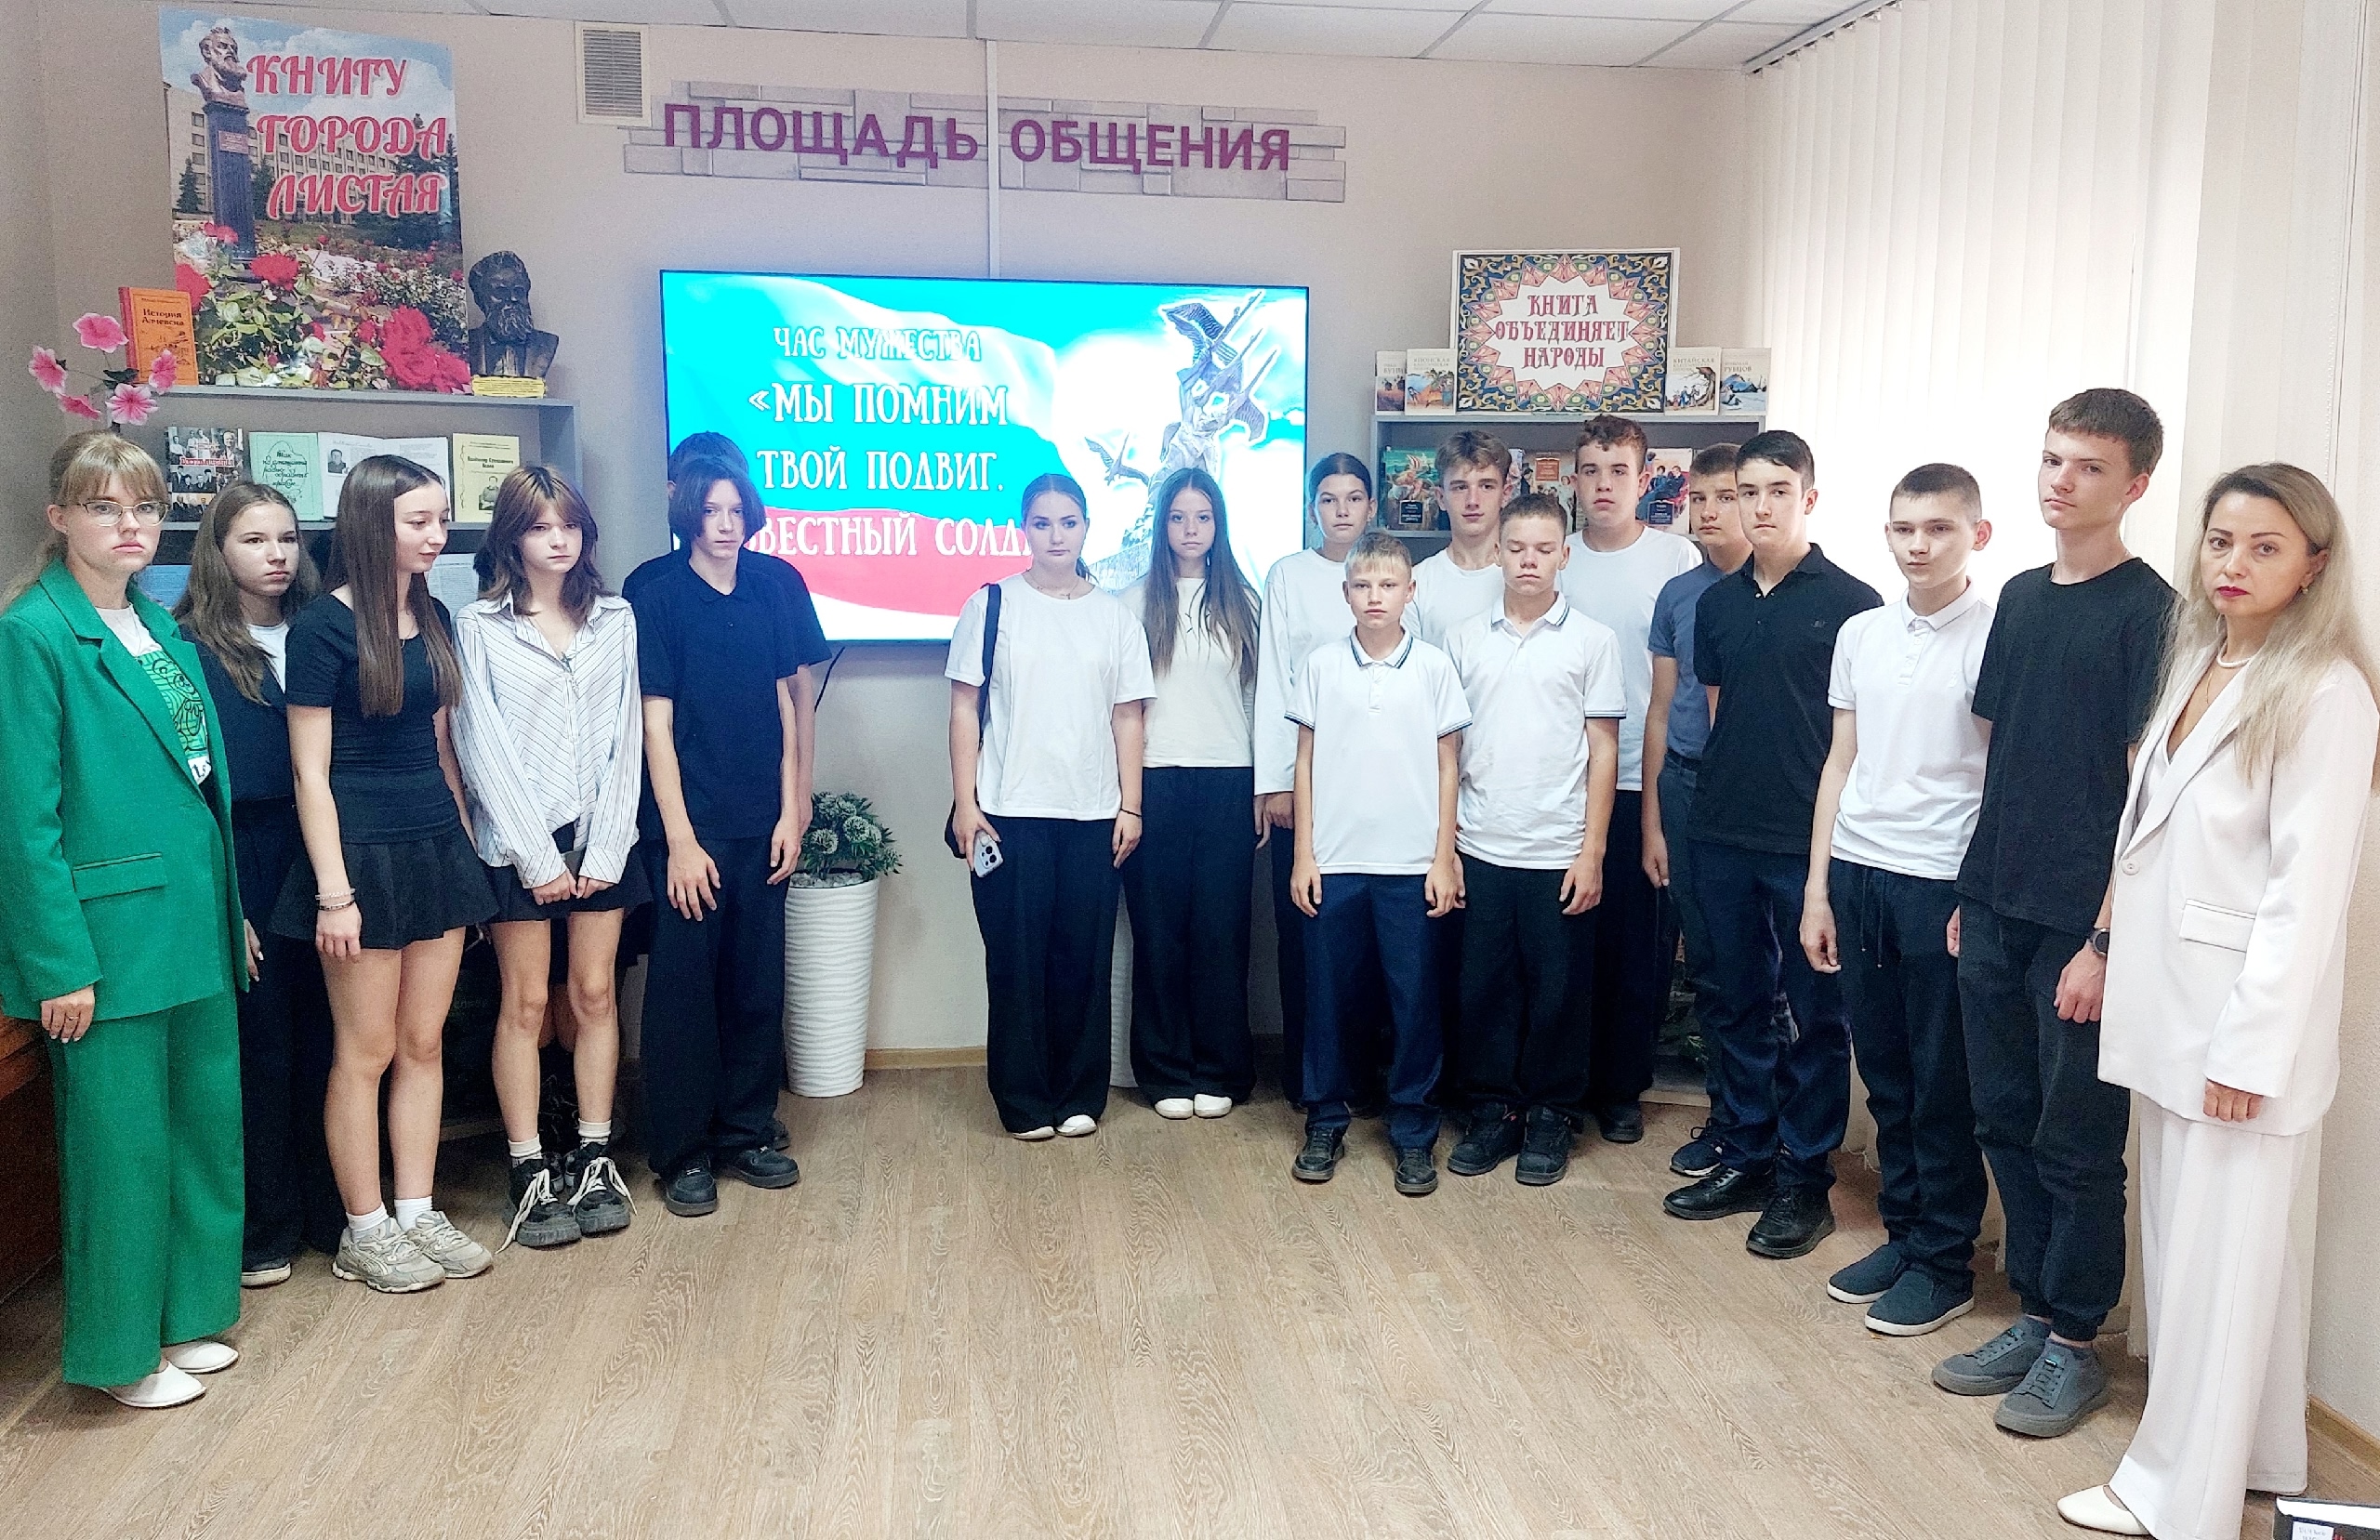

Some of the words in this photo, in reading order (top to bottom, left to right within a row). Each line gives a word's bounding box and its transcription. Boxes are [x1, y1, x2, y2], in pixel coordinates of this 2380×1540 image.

[245, 54, 408, 97] КНИГУ
[256, 114, 447, 160] ГОРОДА
[665, 103, 979, 169] ПЛОЩАДЬ
[1011, 118, 1290, 175] ОБЩЕНИЯ
[267, 173, 446, 218] ЛИСТАЯ
[142, 308, 182, 319] История
[1527, 295, 1598, 317] КНИГА
[773, 326, 826, 358] ЧАС
[836, 327, 982, 362] МУЖЕСТВА
[1495, 321, 1630, 344] ОБЪЕДИНЯЕТ
[1522, 347, 1606, 370] НАРОДЫ
[747, 381, 834, 423] «МЫ
[853, 382, 1008, 426] ПОМНИМ
[756, 444, 848, 490] ТВОЙ
[866, 450, 1004, 492] ПОДВИГ.
